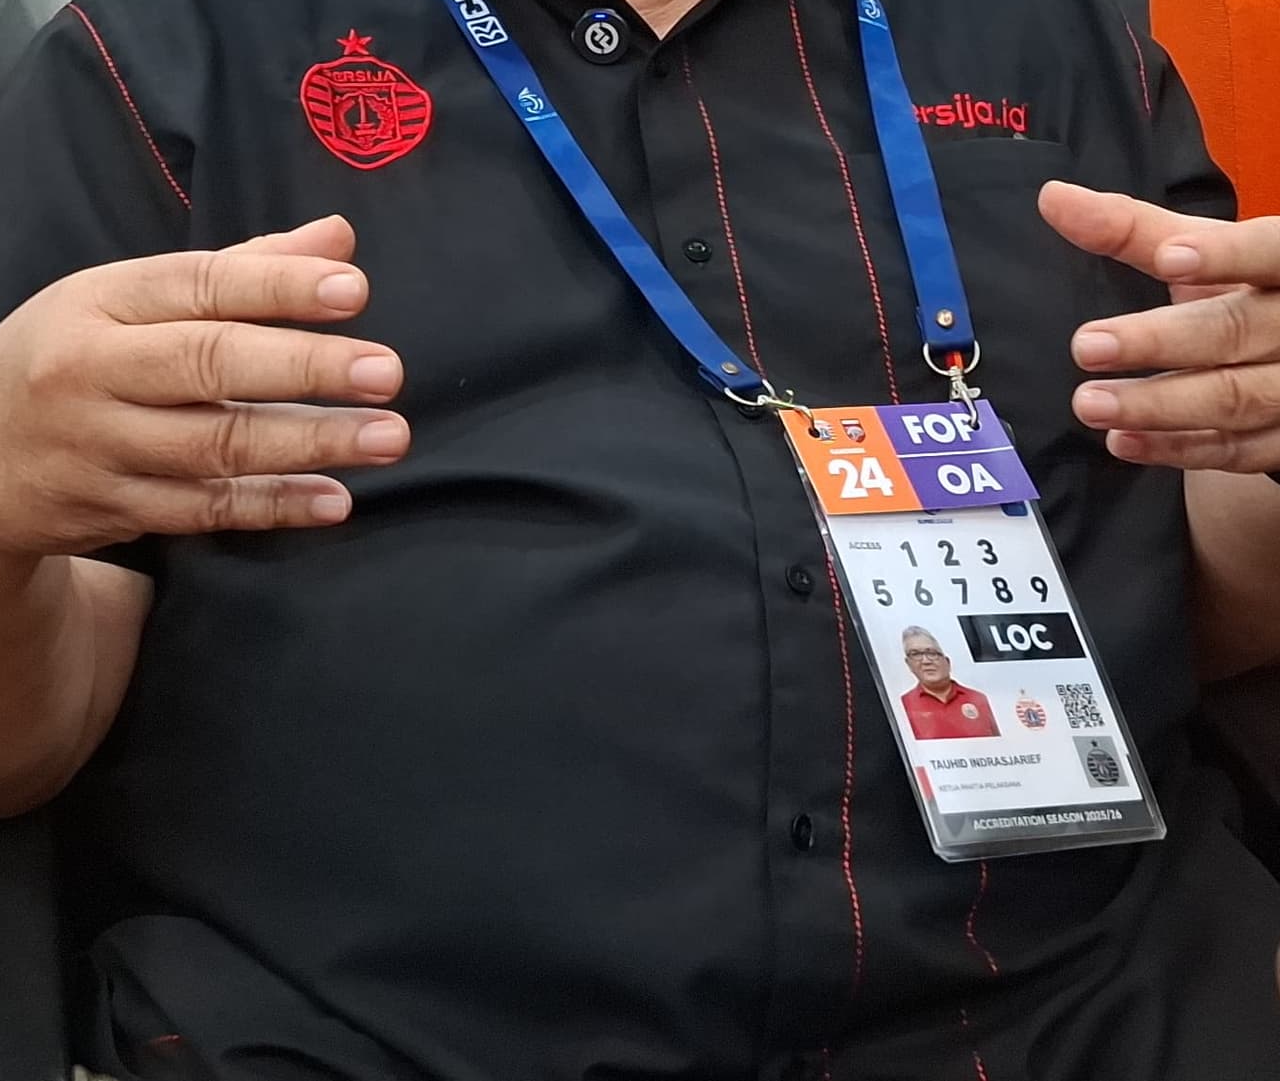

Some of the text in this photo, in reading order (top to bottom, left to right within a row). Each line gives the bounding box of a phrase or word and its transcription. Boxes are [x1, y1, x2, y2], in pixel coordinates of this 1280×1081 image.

[827, 457, 895, 499] 24
[937, 463, 1004, 495] OA
[899, 541, 918, 568] 1
[937, 540, 961, 567] 2
[976, 539, 999, 566] 3
[872, 576, 1049, 607] 5 6 7 8 9
[989, 623, 1054, 652] LOC
[930, 758, 968, 770] TAUHID
[973, 814, 1046, 830] ACCREDITATION
[1046, 811, 1085, 825] SEASON
